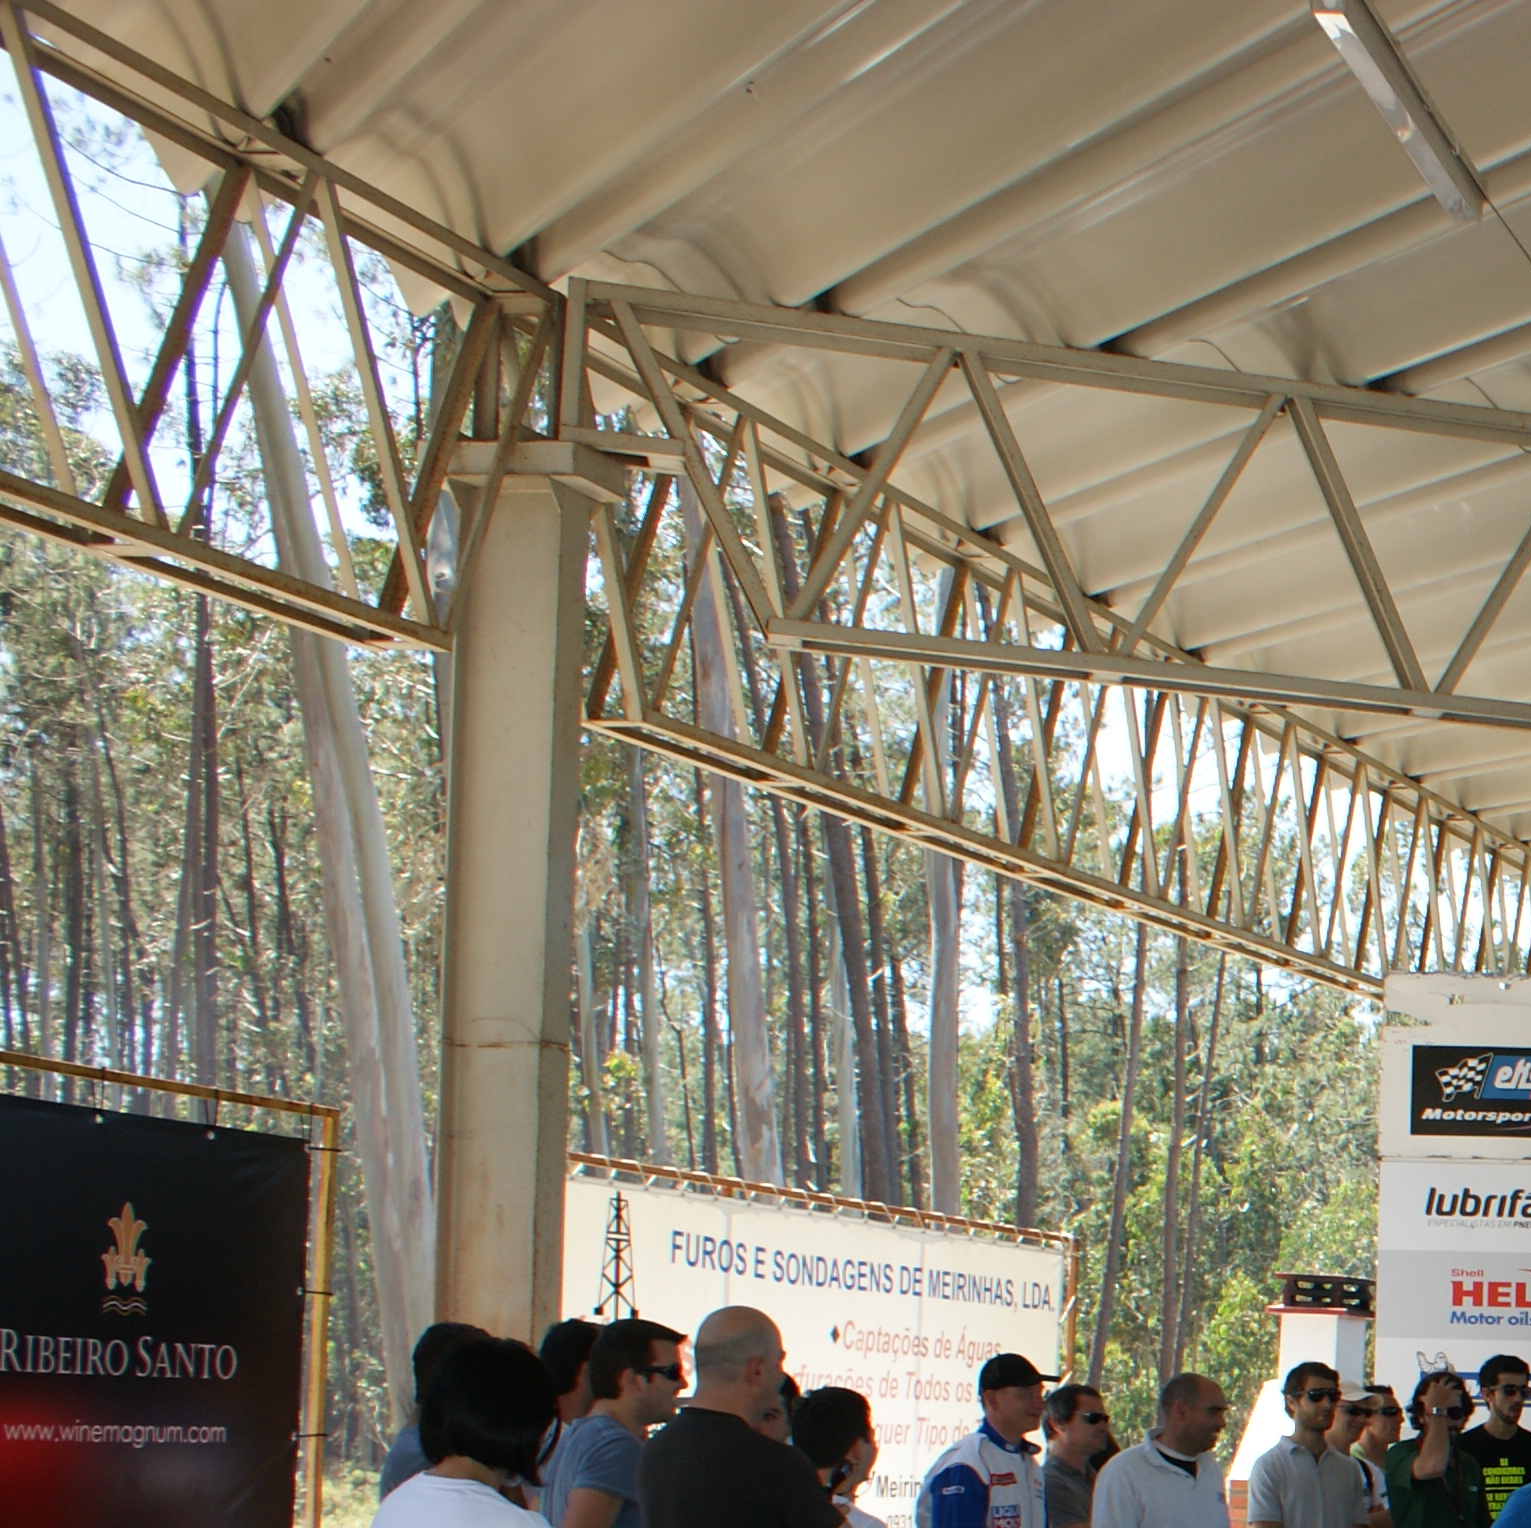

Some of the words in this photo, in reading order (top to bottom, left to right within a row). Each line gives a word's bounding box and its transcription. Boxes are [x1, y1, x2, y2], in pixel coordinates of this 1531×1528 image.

[670, 1229, 747, 1276] FUROS
[754, 1246, 766, 1279] E
[772, 1250, 894, 1294] SONDAGENS
[899, 1265, 922, 1297] DE
[928, 1269, 1018, 1312] MEIRINHAS,
[1022, 1282, 1056, 1312] LDA.
[1452, 1268, 1484, 1277] Shell
[1450, 1311, 1504, 1325] Motor
[0, 1328, 129, 1376] RIBEIRO
[135, 1335, 238, 1380] SANTO
[843, 1320, 930, 1362] Captações
[934, 1331, 952, 1359] de
[879, 1370, 899, 1399] de
[906, 1371, 950, 1402] Todos
[956, 1381, 972, 1403] os
[4, 1419, 226, 1448] www.winemagnum.com
[916, 1417, 948, 1451] Tipo
